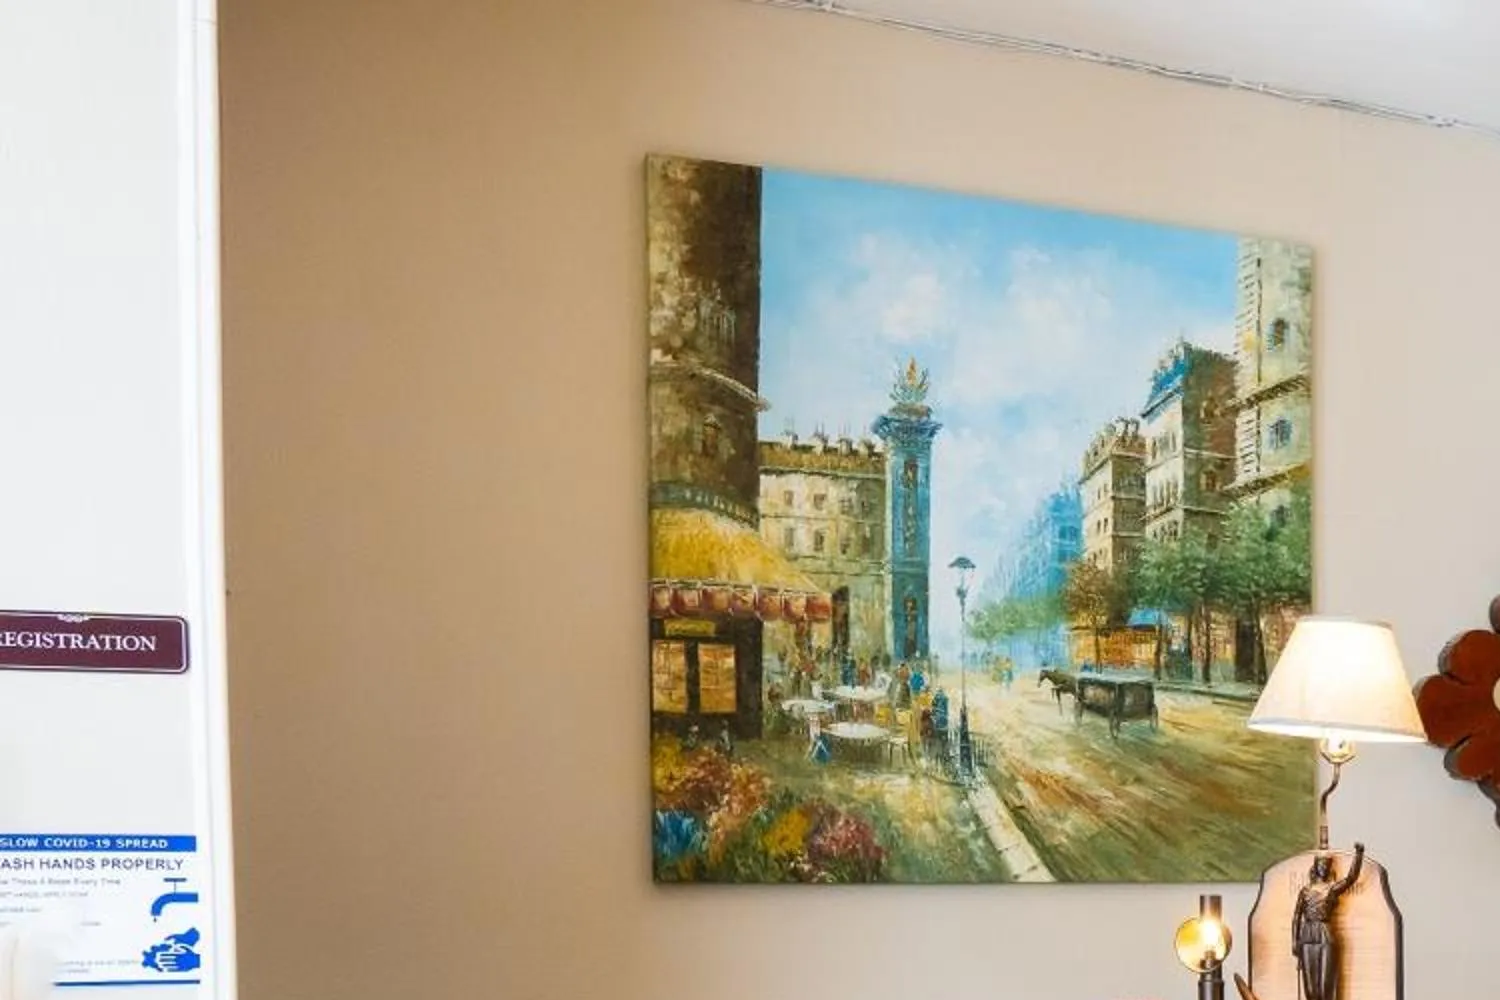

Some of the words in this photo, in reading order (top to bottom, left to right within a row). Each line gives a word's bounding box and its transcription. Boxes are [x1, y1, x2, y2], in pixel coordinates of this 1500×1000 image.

[0, 837, 39, 849] SLOW
[44, 838, 111, 849] COVID-19
[115, 838, 168, 849] SPREAD
[40, 857, 95, 870] HANDS
[101, 857, 184, 870] PROPERLY
